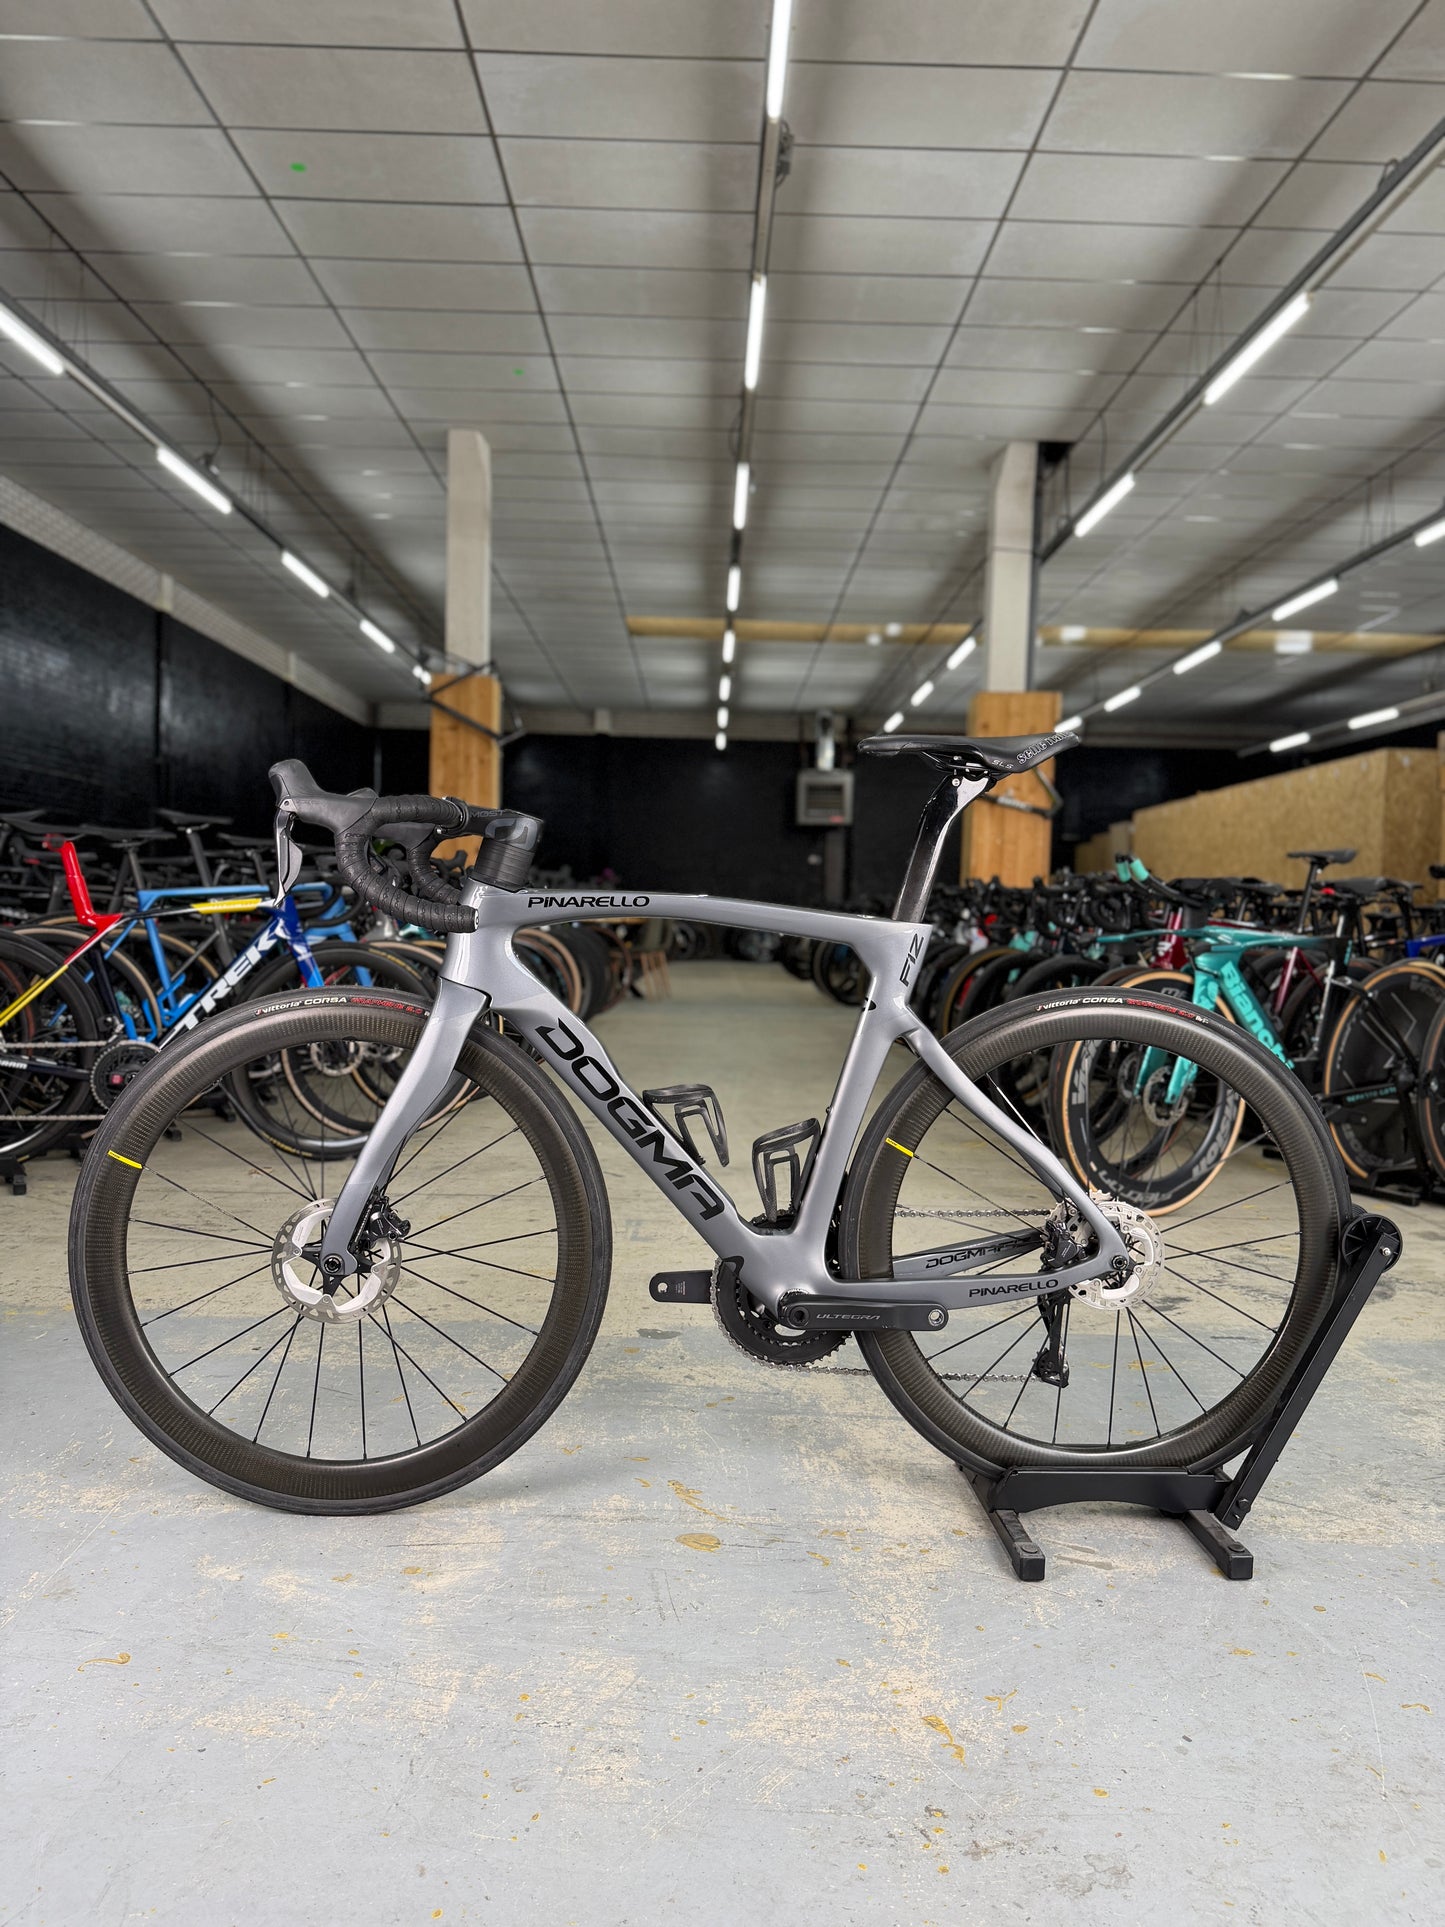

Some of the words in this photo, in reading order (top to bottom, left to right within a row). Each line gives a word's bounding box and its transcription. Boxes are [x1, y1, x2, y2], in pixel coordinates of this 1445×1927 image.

[528, 896, 650, 908] PINARELLO
[173, 928, 278, 1032] TREK
[304, 996, 348, 1005] CORSA
[1082, 997, 1124, 1005] CORSA
[1220, 960, 1295, 1070] Bianchi
[534, 1017, 725, 1221] DOGMA
[968, 1278, 1059, 1298] PINARELLO
